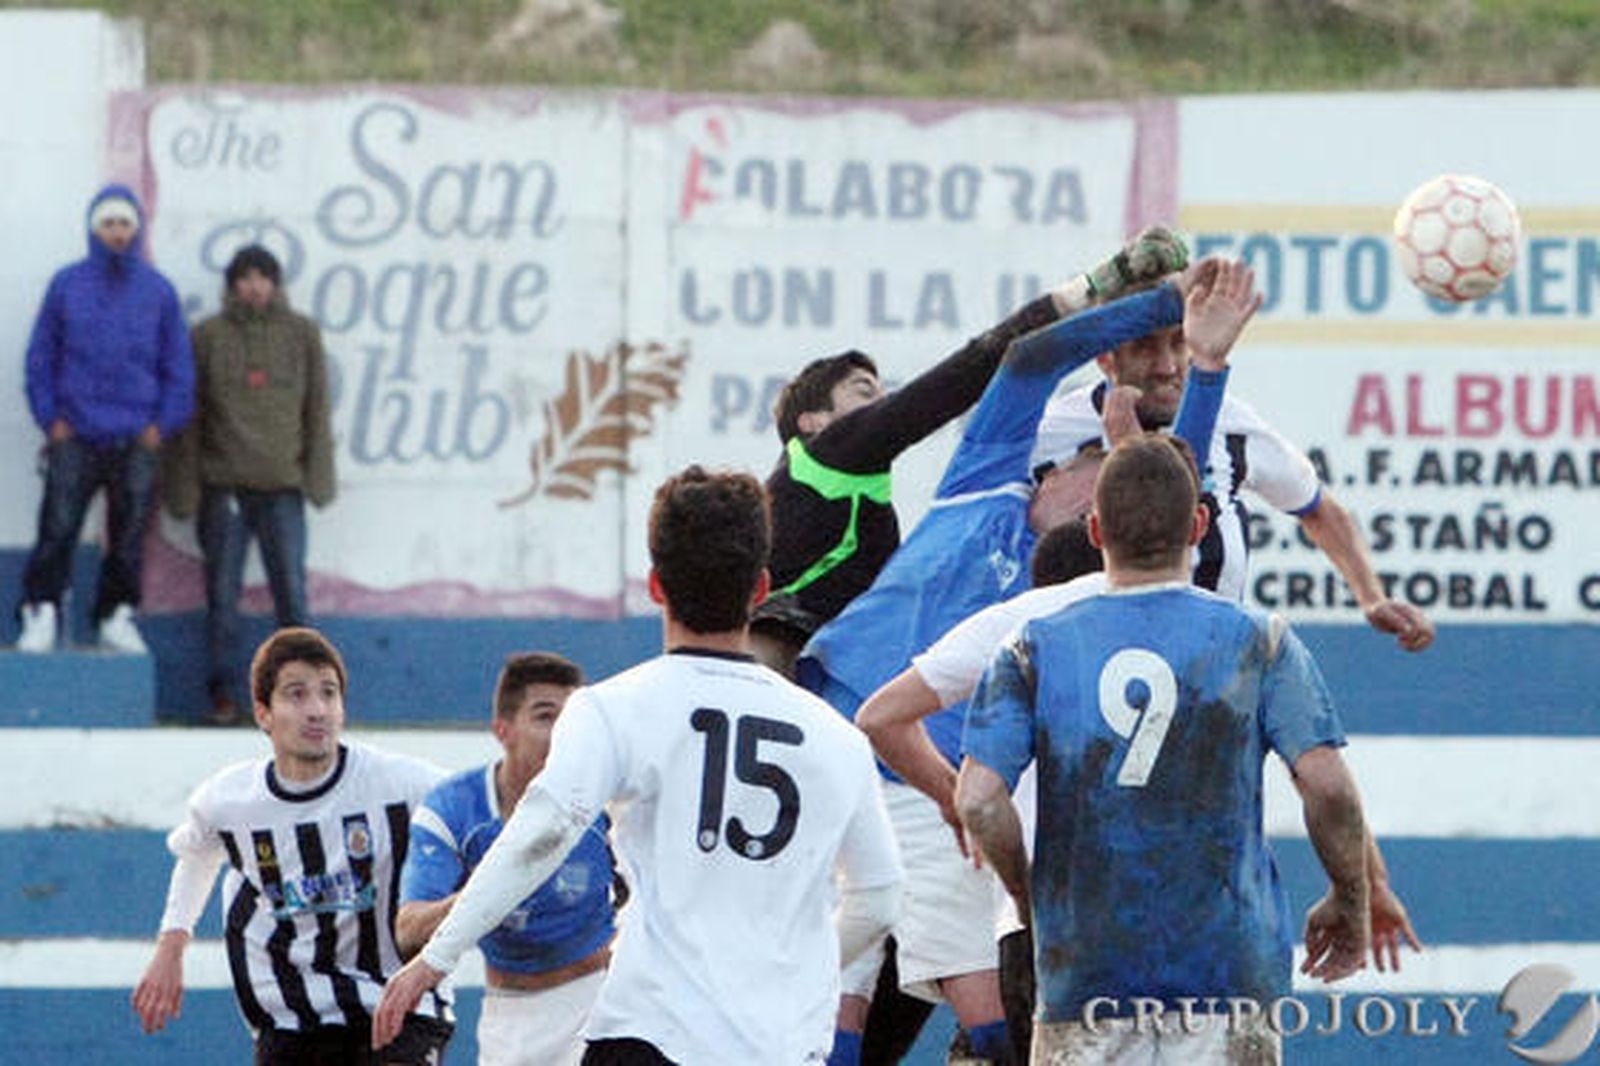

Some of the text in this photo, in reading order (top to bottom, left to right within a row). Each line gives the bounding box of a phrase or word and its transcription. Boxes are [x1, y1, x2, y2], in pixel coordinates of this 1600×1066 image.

[171, 97, 281, 170] The
[315, 103, 564, 247] San
[683, 157, 1088, 224] OLABORA
[867, 270, 959, 331] LA
[325, 343, 511, 466] lub
[1099, 648, 1178, 787] 9
[690, 707, 804, 861] 15
